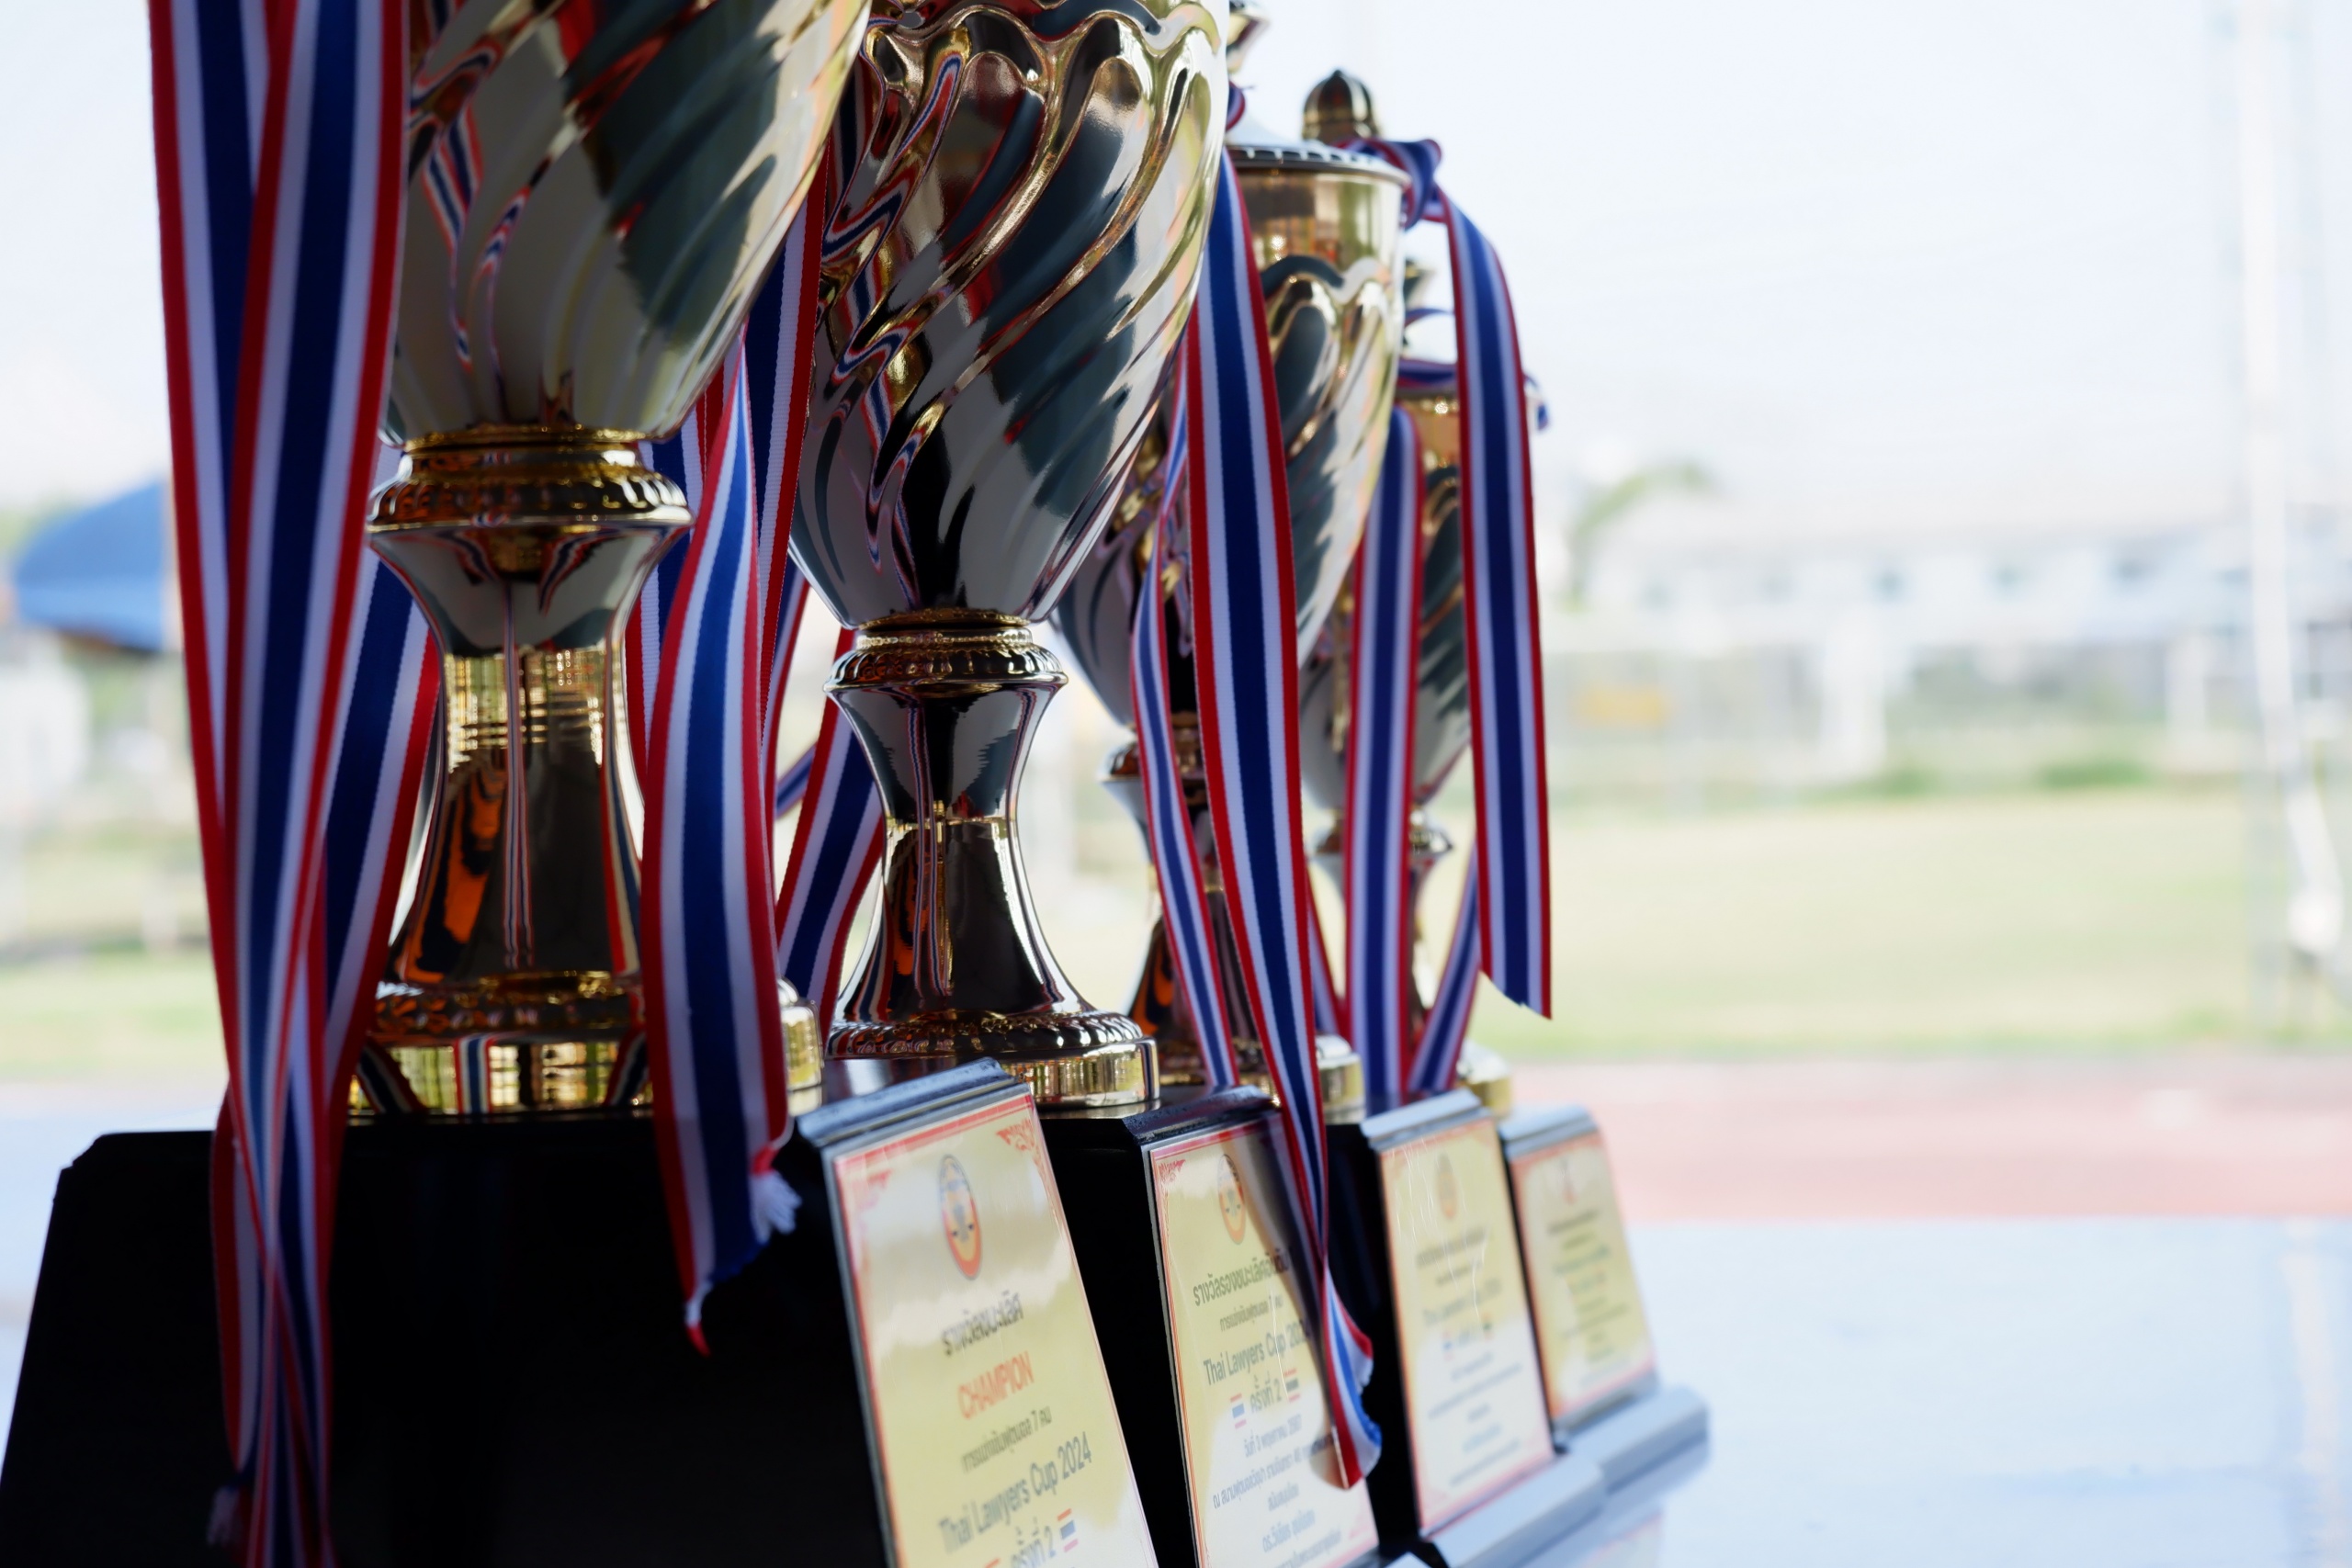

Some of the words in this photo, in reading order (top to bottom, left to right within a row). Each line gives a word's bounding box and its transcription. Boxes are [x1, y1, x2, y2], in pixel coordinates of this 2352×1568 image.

[957, 1351, 1035, 1419] CHAMPION
[1204, 1351, 1227, 1385] Thai
[1226, 1341, 1265, 1373] Lawyers
[1274, 1378, 1283, 1402] 2
[938, 1503, 974, 1554] Thai
[970, 1479, 1030, 1533] Lawyers
[1030, 1461, 1058, 1496] Cup
[1057, 1431, 1092, 1480] 2024
[1044, 1525, 1057, 1559] 2
